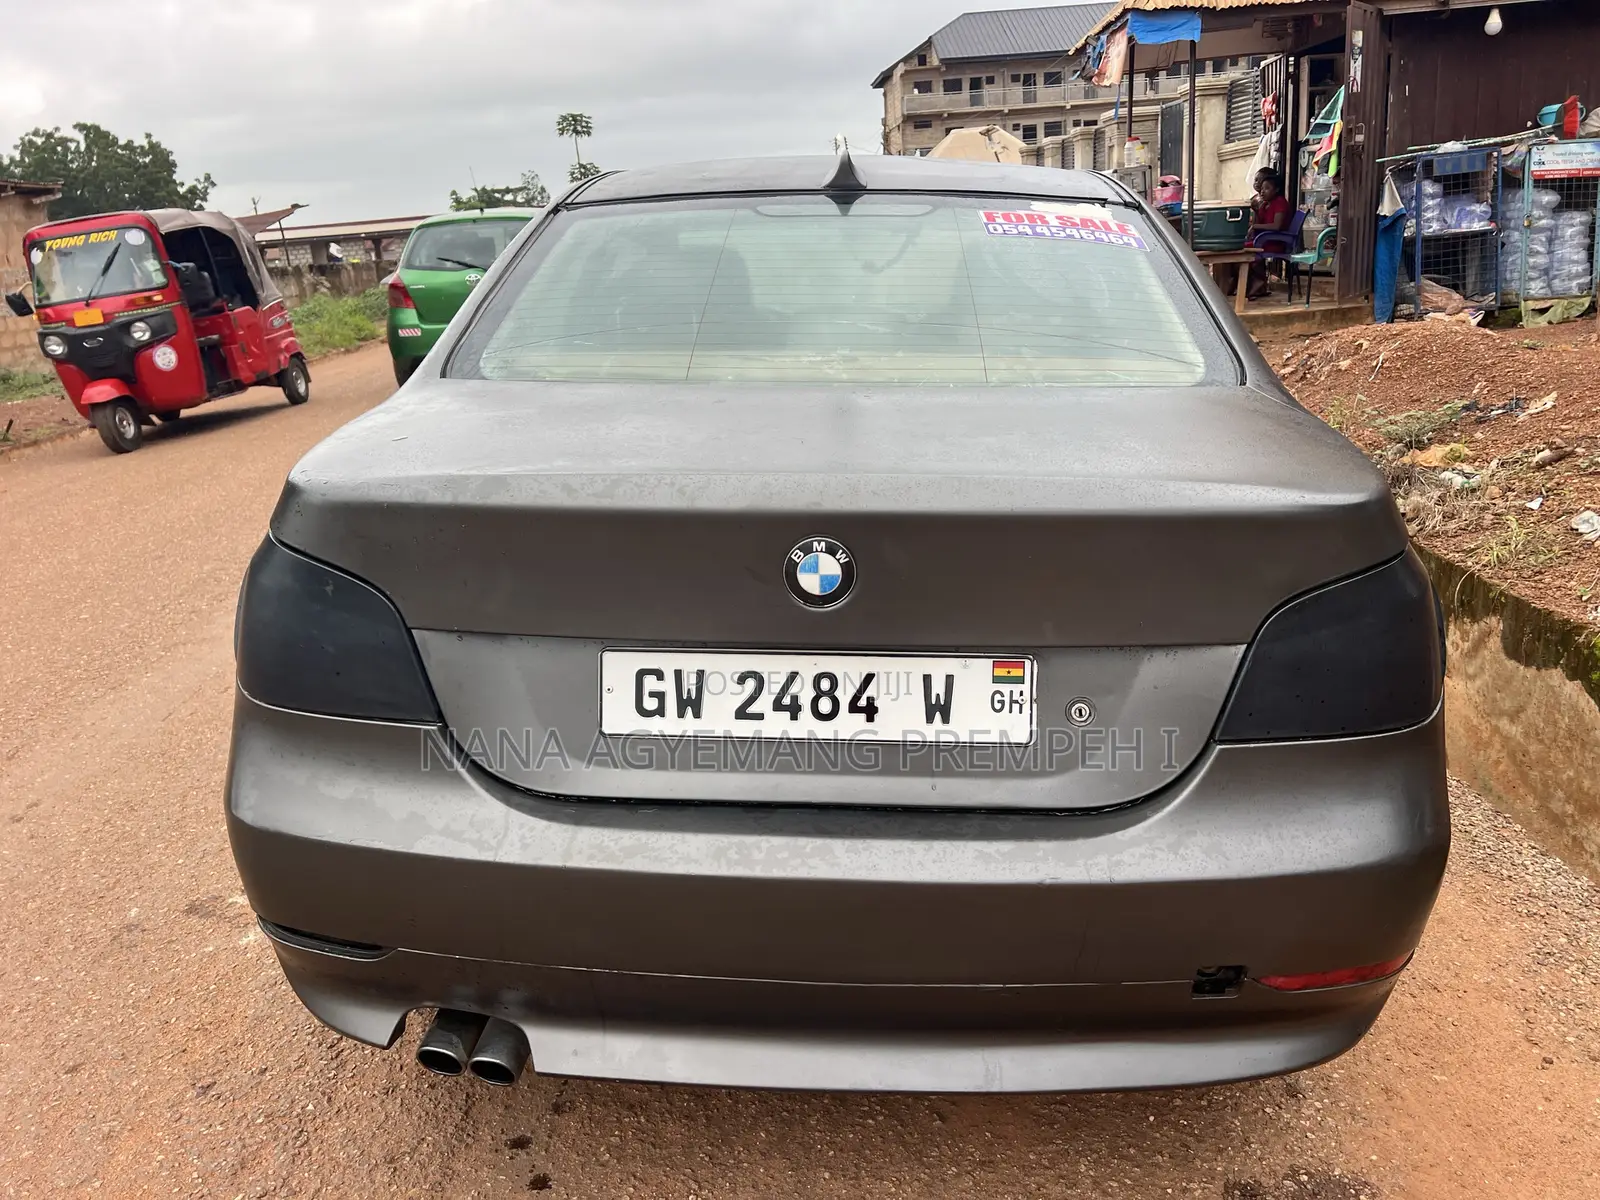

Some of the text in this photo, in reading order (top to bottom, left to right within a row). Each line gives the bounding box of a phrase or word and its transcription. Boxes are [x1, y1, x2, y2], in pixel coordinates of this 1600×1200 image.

[983, 211, 1136, 237] FOR SALE
[45, 230, 118, 252] YOUNG RICH
[791, 541, 850, 564] BMW
[634, 668, 955, 725] GW 2484 W
[990, 689, 1024, 714] GH
